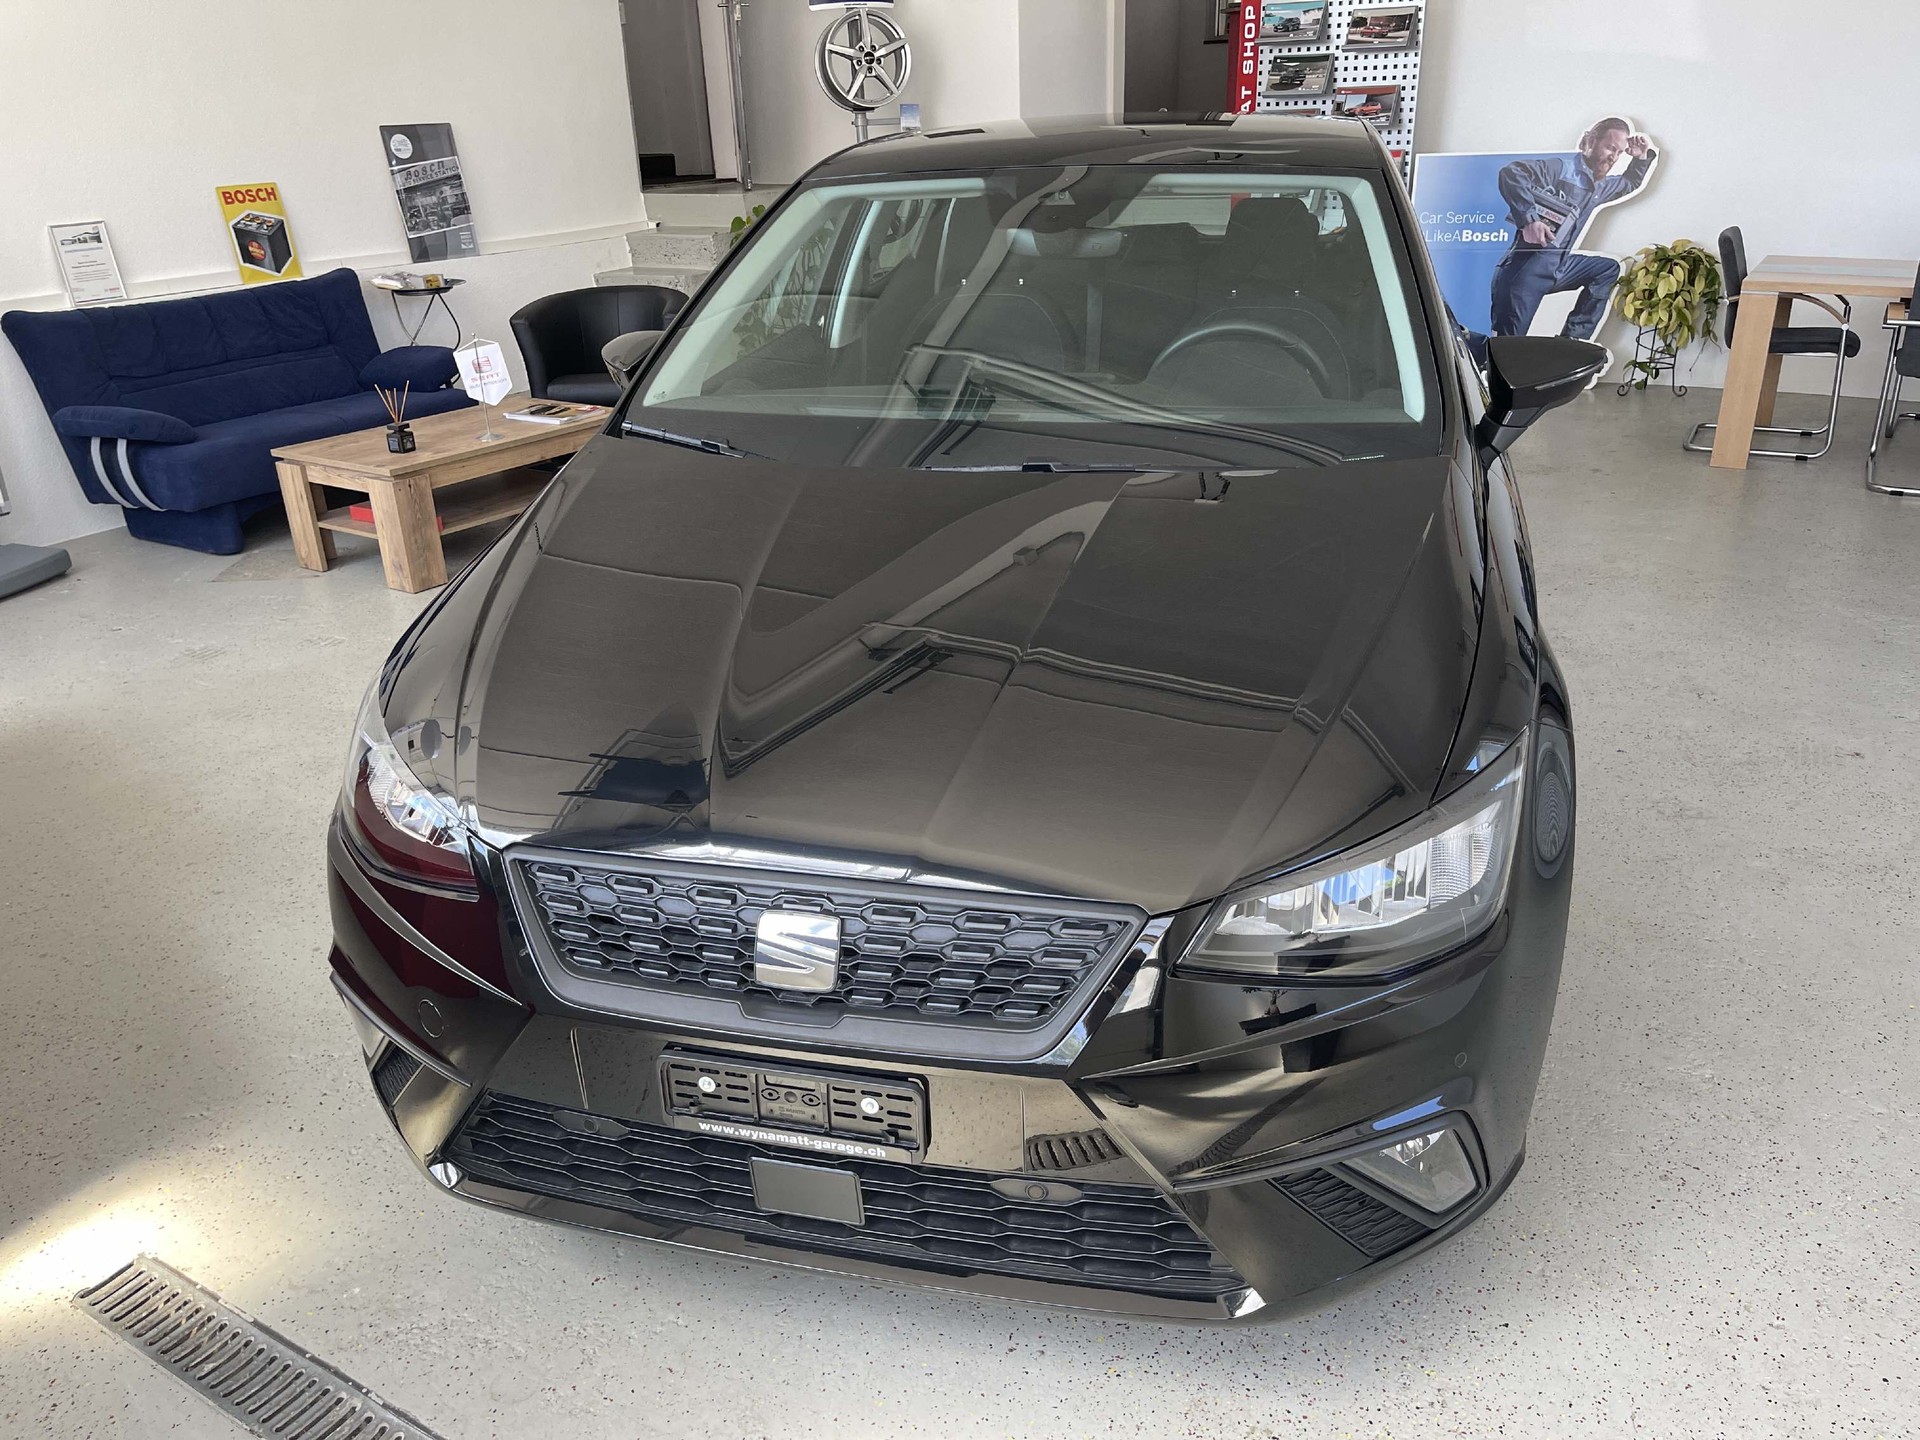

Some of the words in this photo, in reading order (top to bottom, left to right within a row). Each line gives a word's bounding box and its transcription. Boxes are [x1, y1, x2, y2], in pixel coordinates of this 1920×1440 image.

[1243, 5, 1256, 75] SHOP
[1241, 86, 1252, 112] AT
[404, 161, 446, 181] BOSCH
[222, 187, 278, 205] BOSCH
[1420, 211, 1443, 224] Car
[1446, 210, 1495, 224] Service
[1423, 229, 1508, 242] LikeABosch
[698, 1121, 886, 1158] www.wynamatt-garage.ch
